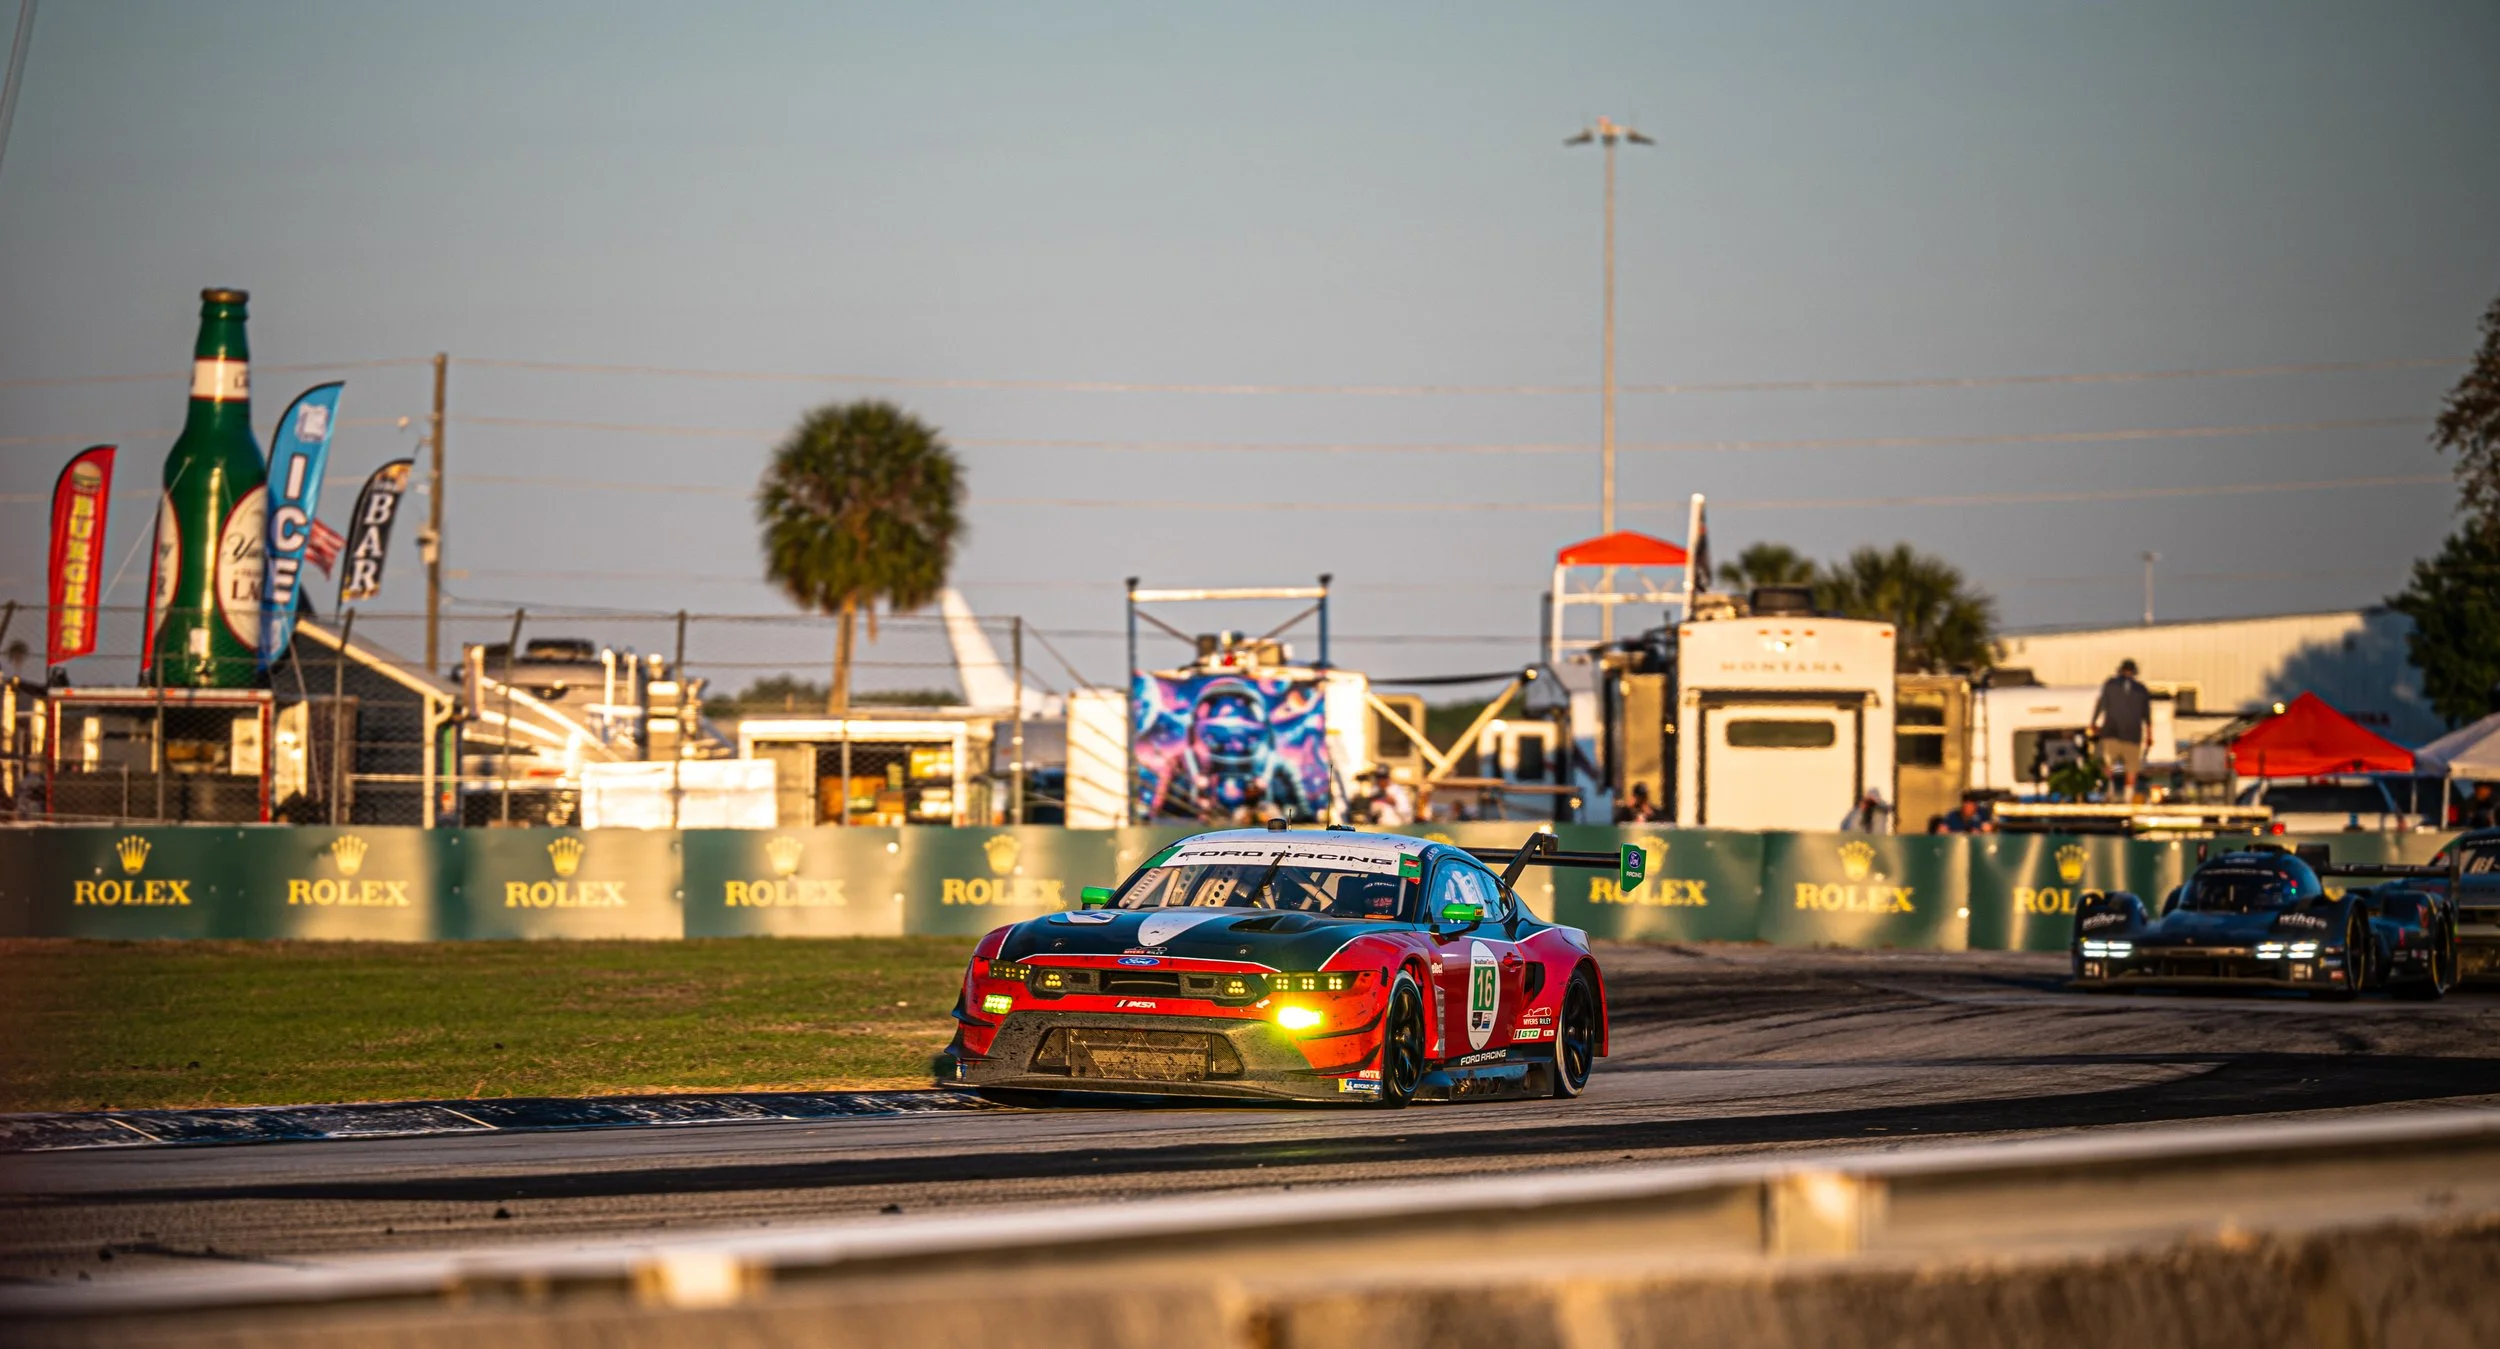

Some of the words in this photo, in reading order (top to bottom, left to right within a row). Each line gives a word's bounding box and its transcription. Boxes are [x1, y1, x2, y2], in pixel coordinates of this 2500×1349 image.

[352, 493, 394, 592] BAR
[61, 494, 95, 650] BURGERS
[1719, 660, 1844, 673] MONTANA
[1178, 850, 1263, 859] FORD
[1270, 850, 1398, 866] RACING
[1626, 870, 1642, 878] RACING
[74, 879, 192, 905] ROLEX
[287, 879, 411, 907] ROLEX
[505, 880, 628, 908] ROLEX
[725, 879, 848, 907] ROLEX
[942, 878, 1067, 910] ROLEX
[1795, 882, 1915, 913] ROLEX
[1477, 968, 1494, 1008] 16
[1126, 1000, 1157, 1008] IMSA
[1523, 1018, 1539, 1026] MYERS
[1539, 1017, 1552, 1025] RILEY
[1460, 1052, 1480, 1066] FORD
[1480, 1049, 1507, 1062] RACING
